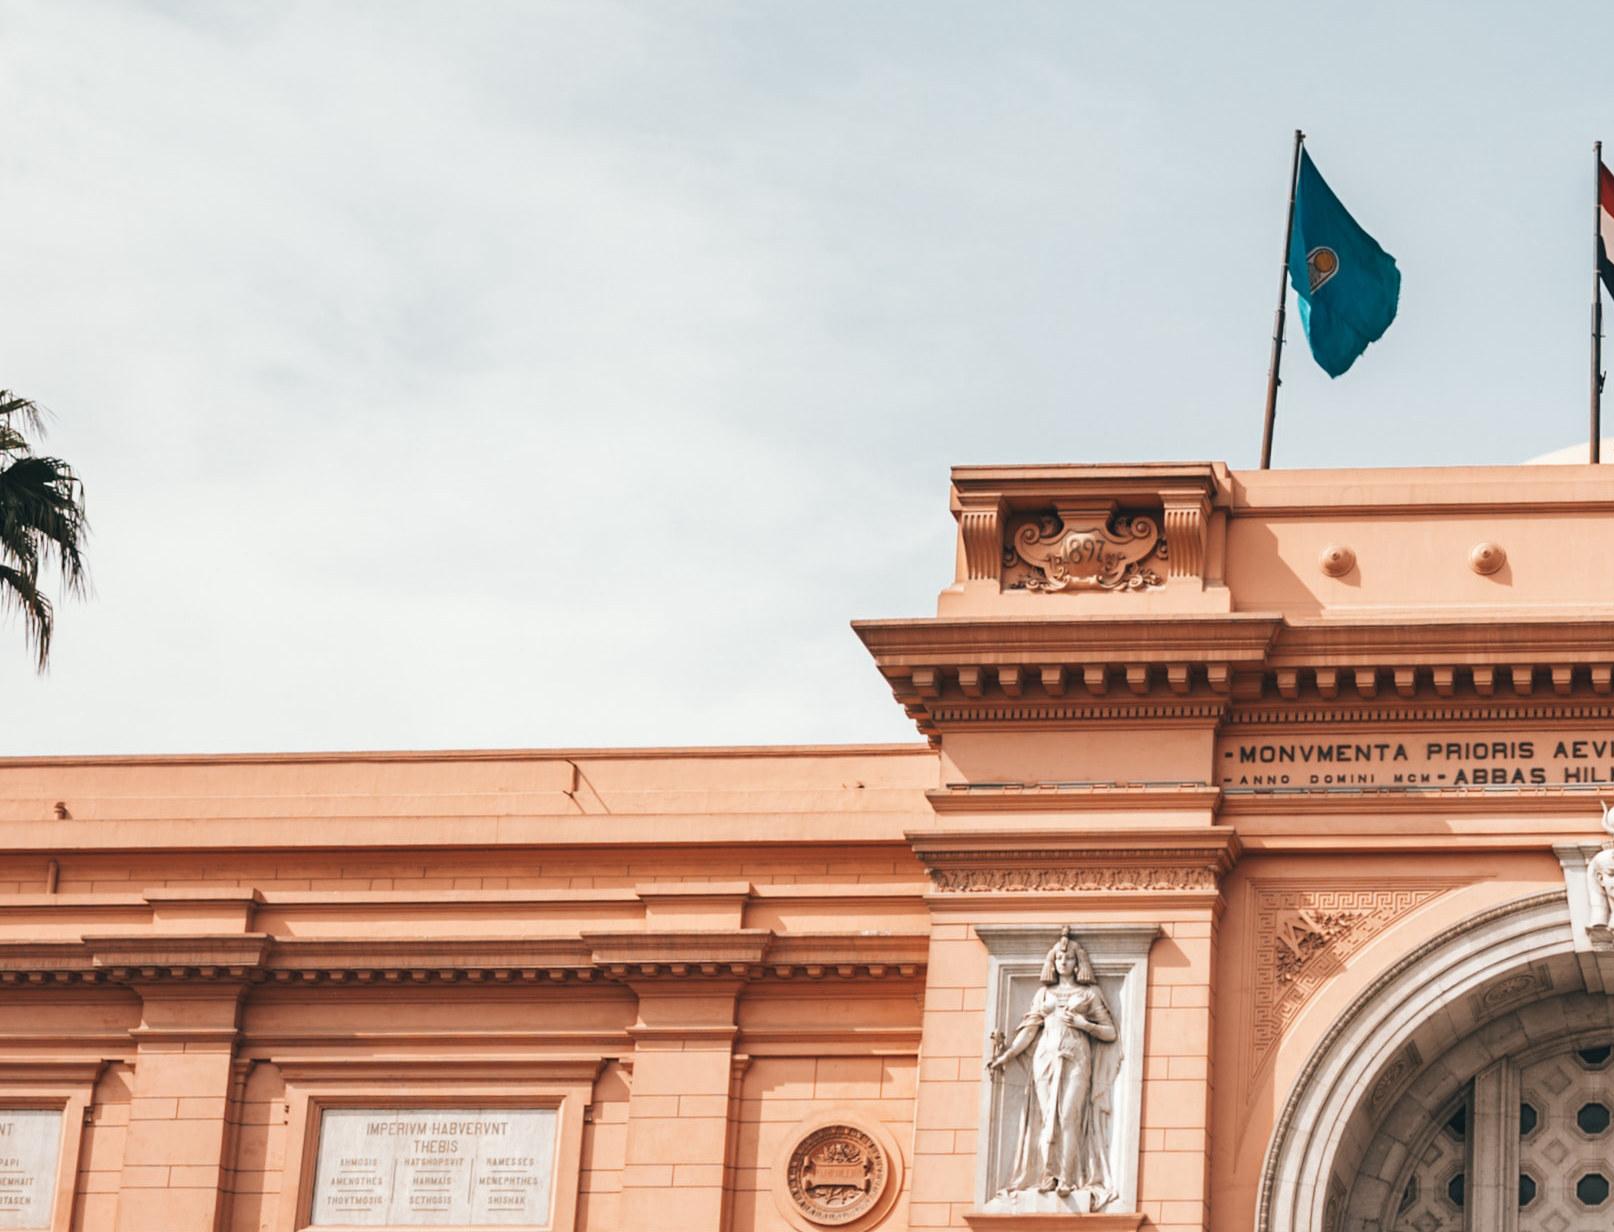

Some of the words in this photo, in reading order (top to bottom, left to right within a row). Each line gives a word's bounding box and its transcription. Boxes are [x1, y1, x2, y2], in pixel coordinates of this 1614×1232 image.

[1238, 744, 1408, 763] MONVMENTA
[1427, 742, 1534, 760] PRIORIS
[1554, 741, 1614, 758] AEVI
[1240, 775, 1289, 784] ANNO
[1310, 774, 1374, 784] DOMINI
[1394, 774, 1430, 783] MCM
[1454, 768, 1546, 784] ABBAS
[366, 1122, 427, 1136] IMPERIVM
[432, 1122, 509, 1136] HABVERVNT
[414, 1139, 459, 1154] THEBIS
